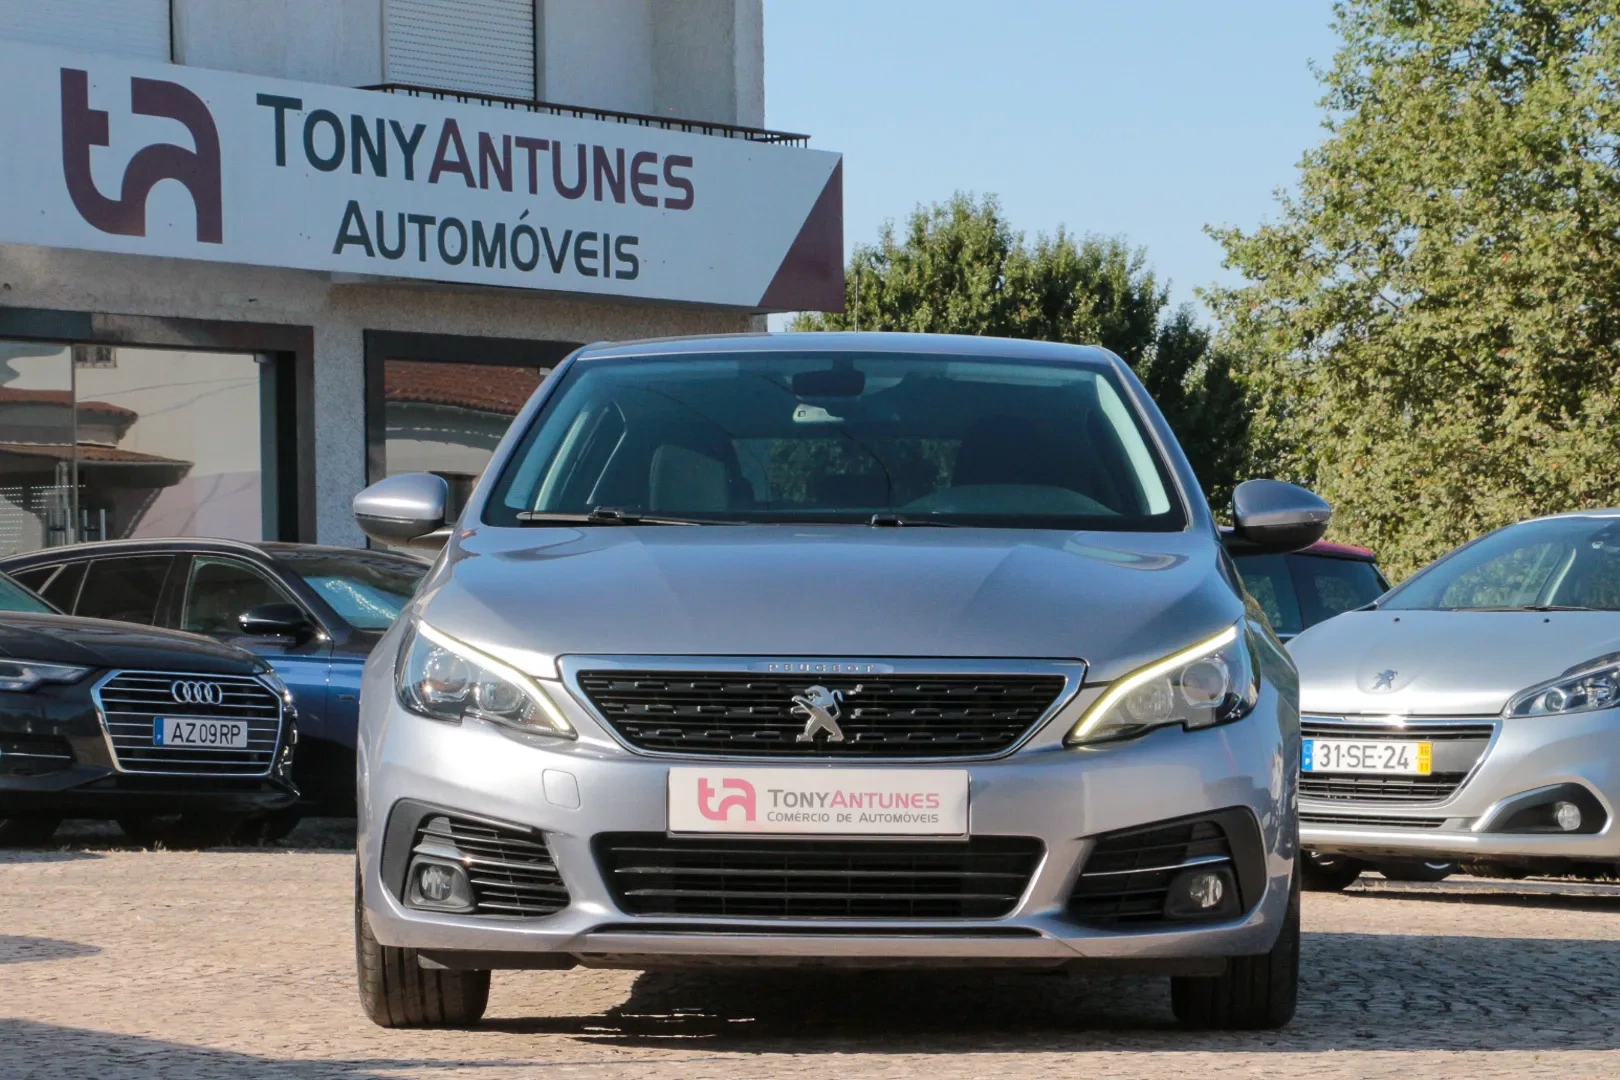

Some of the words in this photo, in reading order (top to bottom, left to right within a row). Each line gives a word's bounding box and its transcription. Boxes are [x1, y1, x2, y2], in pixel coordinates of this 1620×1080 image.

[332, 200, 640, 281] AUTOMÓVEIS
[768, 663, 874, 672] PEUGEOT
[767, 810, 830, 823] COMÉRCIO
[836, 813, 853, 823] DE
[858, 811, 940, 824] AUTOMÓVEIS
